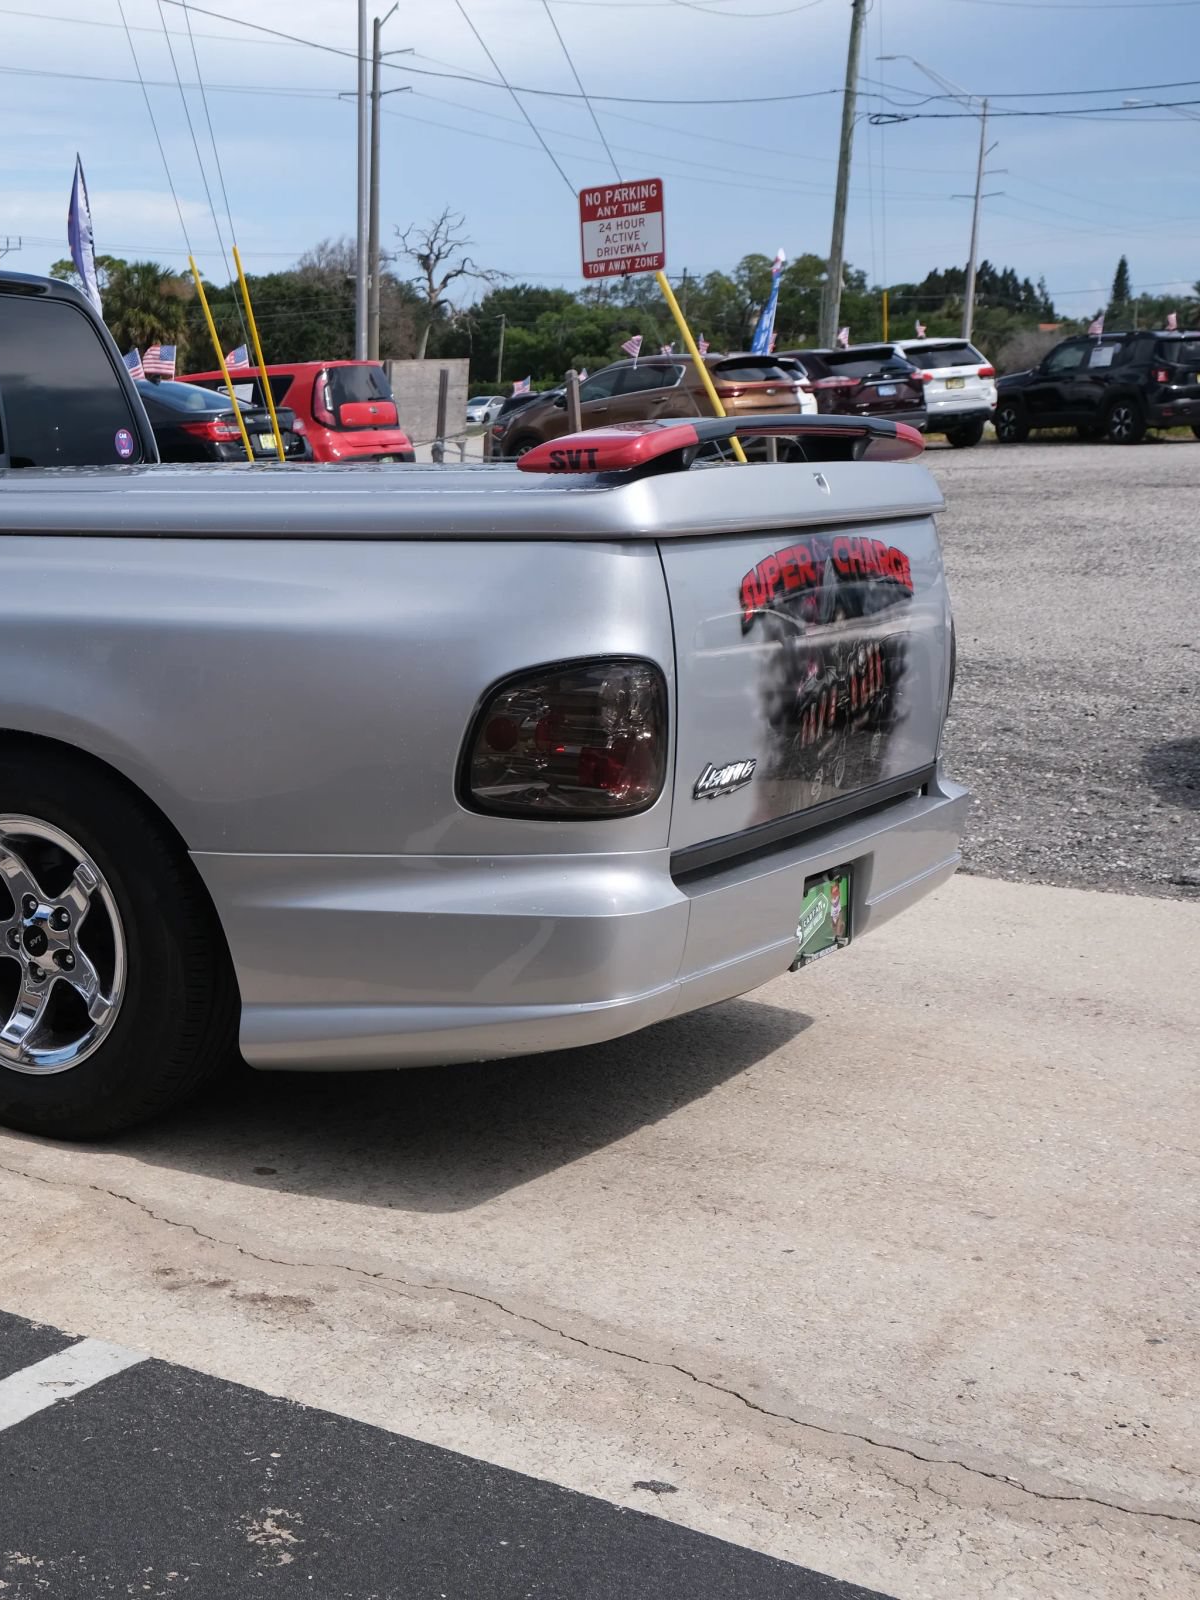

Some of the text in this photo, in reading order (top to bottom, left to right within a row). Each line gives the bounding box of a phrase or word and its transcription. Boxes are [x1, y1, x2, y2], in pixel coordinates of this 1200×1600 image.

[585, 184, 657, 206] NO PARKING
[596, 201, 646, 218] ANY TIME
[599, 218, 645, 233] 24 HOUR
[604, 231, 640, 244] ACTIVE
[596, 242, 648, 257] DRIVEWAY
[588, 256, 658, 274] TOW AWAY ZONE
[549, 448, 599, 470] SVT
[742, 536, 914, 624] SUPER CHARGE
[29, 935, 42, 948] SVT
